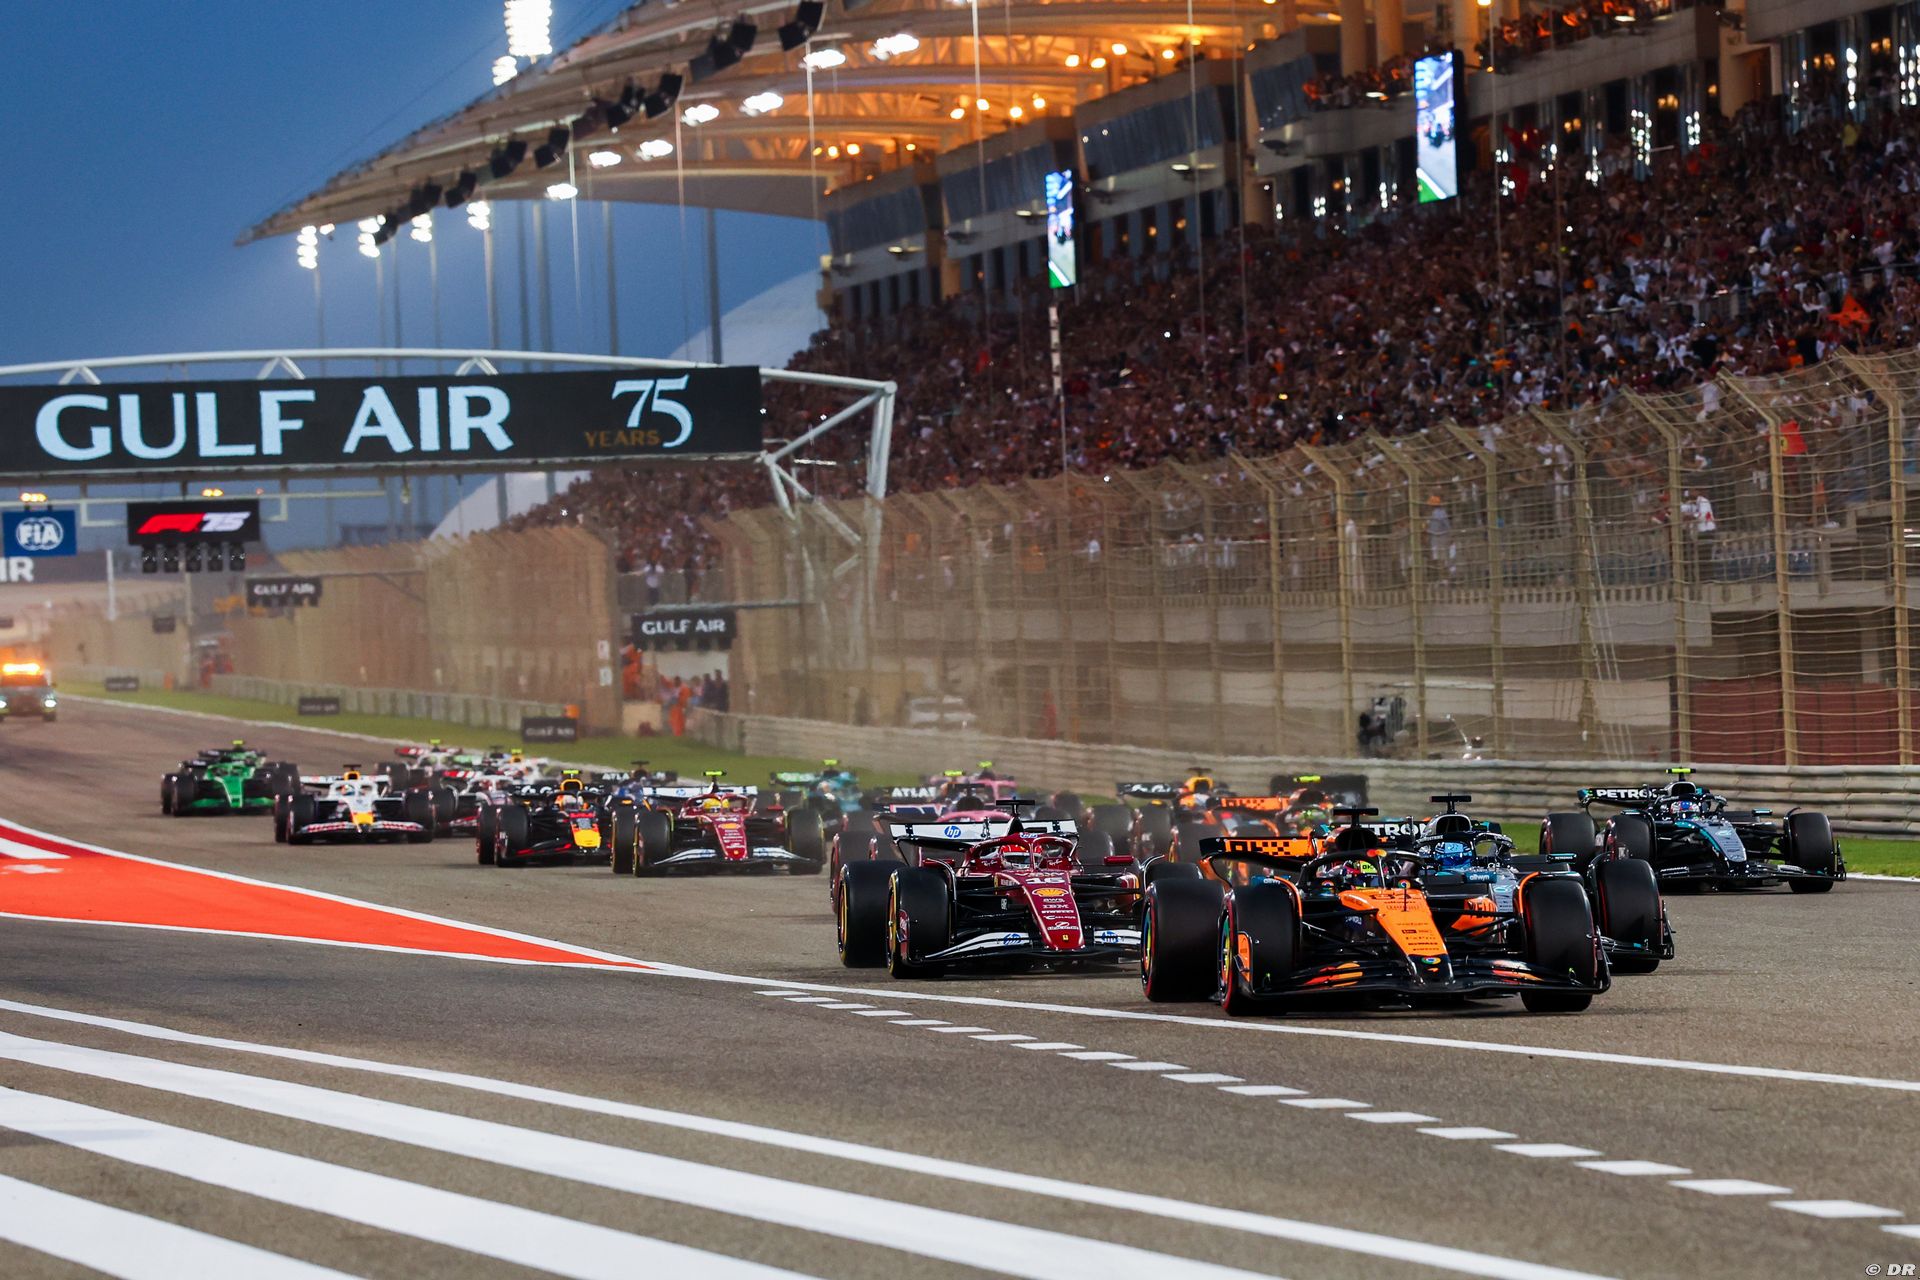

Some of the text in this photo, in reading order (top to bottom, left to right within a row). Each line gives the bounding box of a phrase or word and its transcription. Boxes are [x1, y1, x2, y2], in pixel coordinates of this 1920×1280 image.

[611, 374, 693, 448] 75
[35, 385, 515, 461] GULF AIR
[584, 429, 661, 448] YEARS
[18, 522, 60, 544] FIA
[641, 618, 727, 635] GULF AIR
[944, 825, 962, 839] hp
